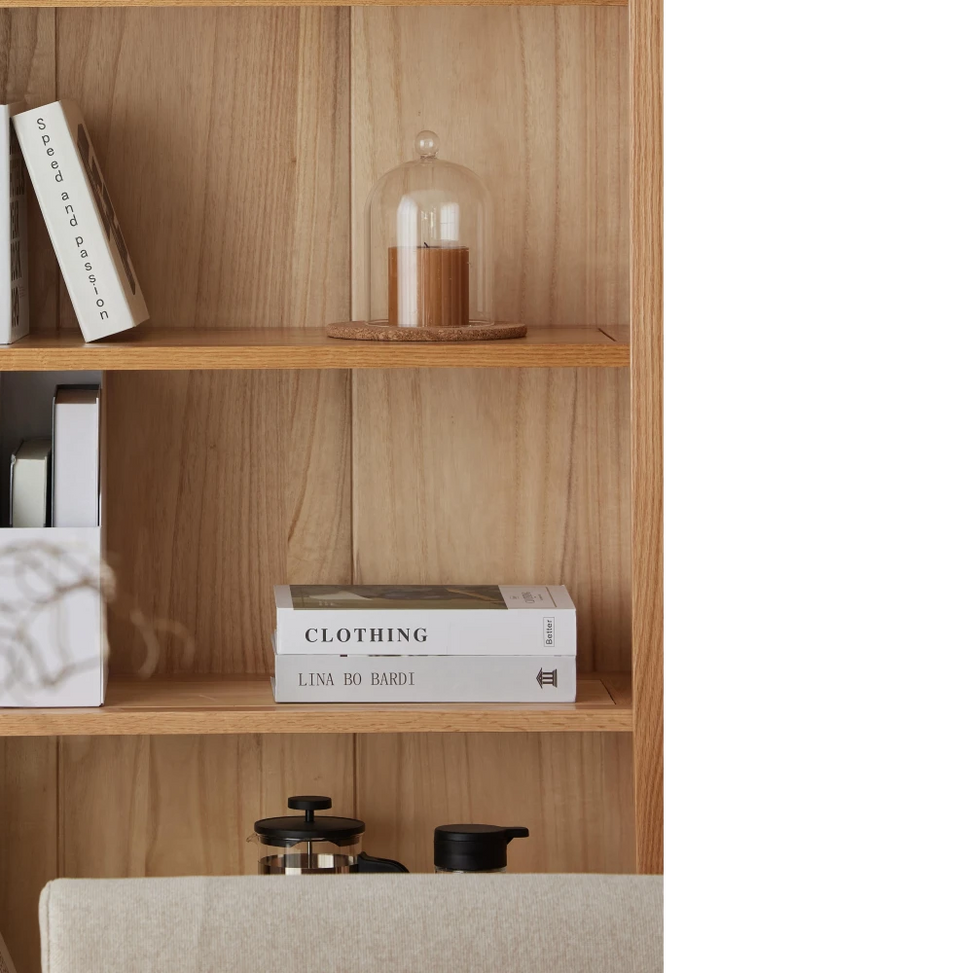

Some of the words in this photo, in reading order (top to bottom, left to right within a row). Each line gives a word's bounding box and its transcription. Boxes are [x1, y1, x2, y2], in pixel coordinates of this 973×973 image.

[36, 117, 64, 183] Speed
[60, 191, 78, 227] and
[75, 235, 109, 320] passion
[305, 628, 428, 643] CLOTHING
[545, 619, 553, 645] Better
[298, 672, 334, 686] LINA
[344, 672, 362, 686] BO
[371, 672, 415, 686] BARDI
